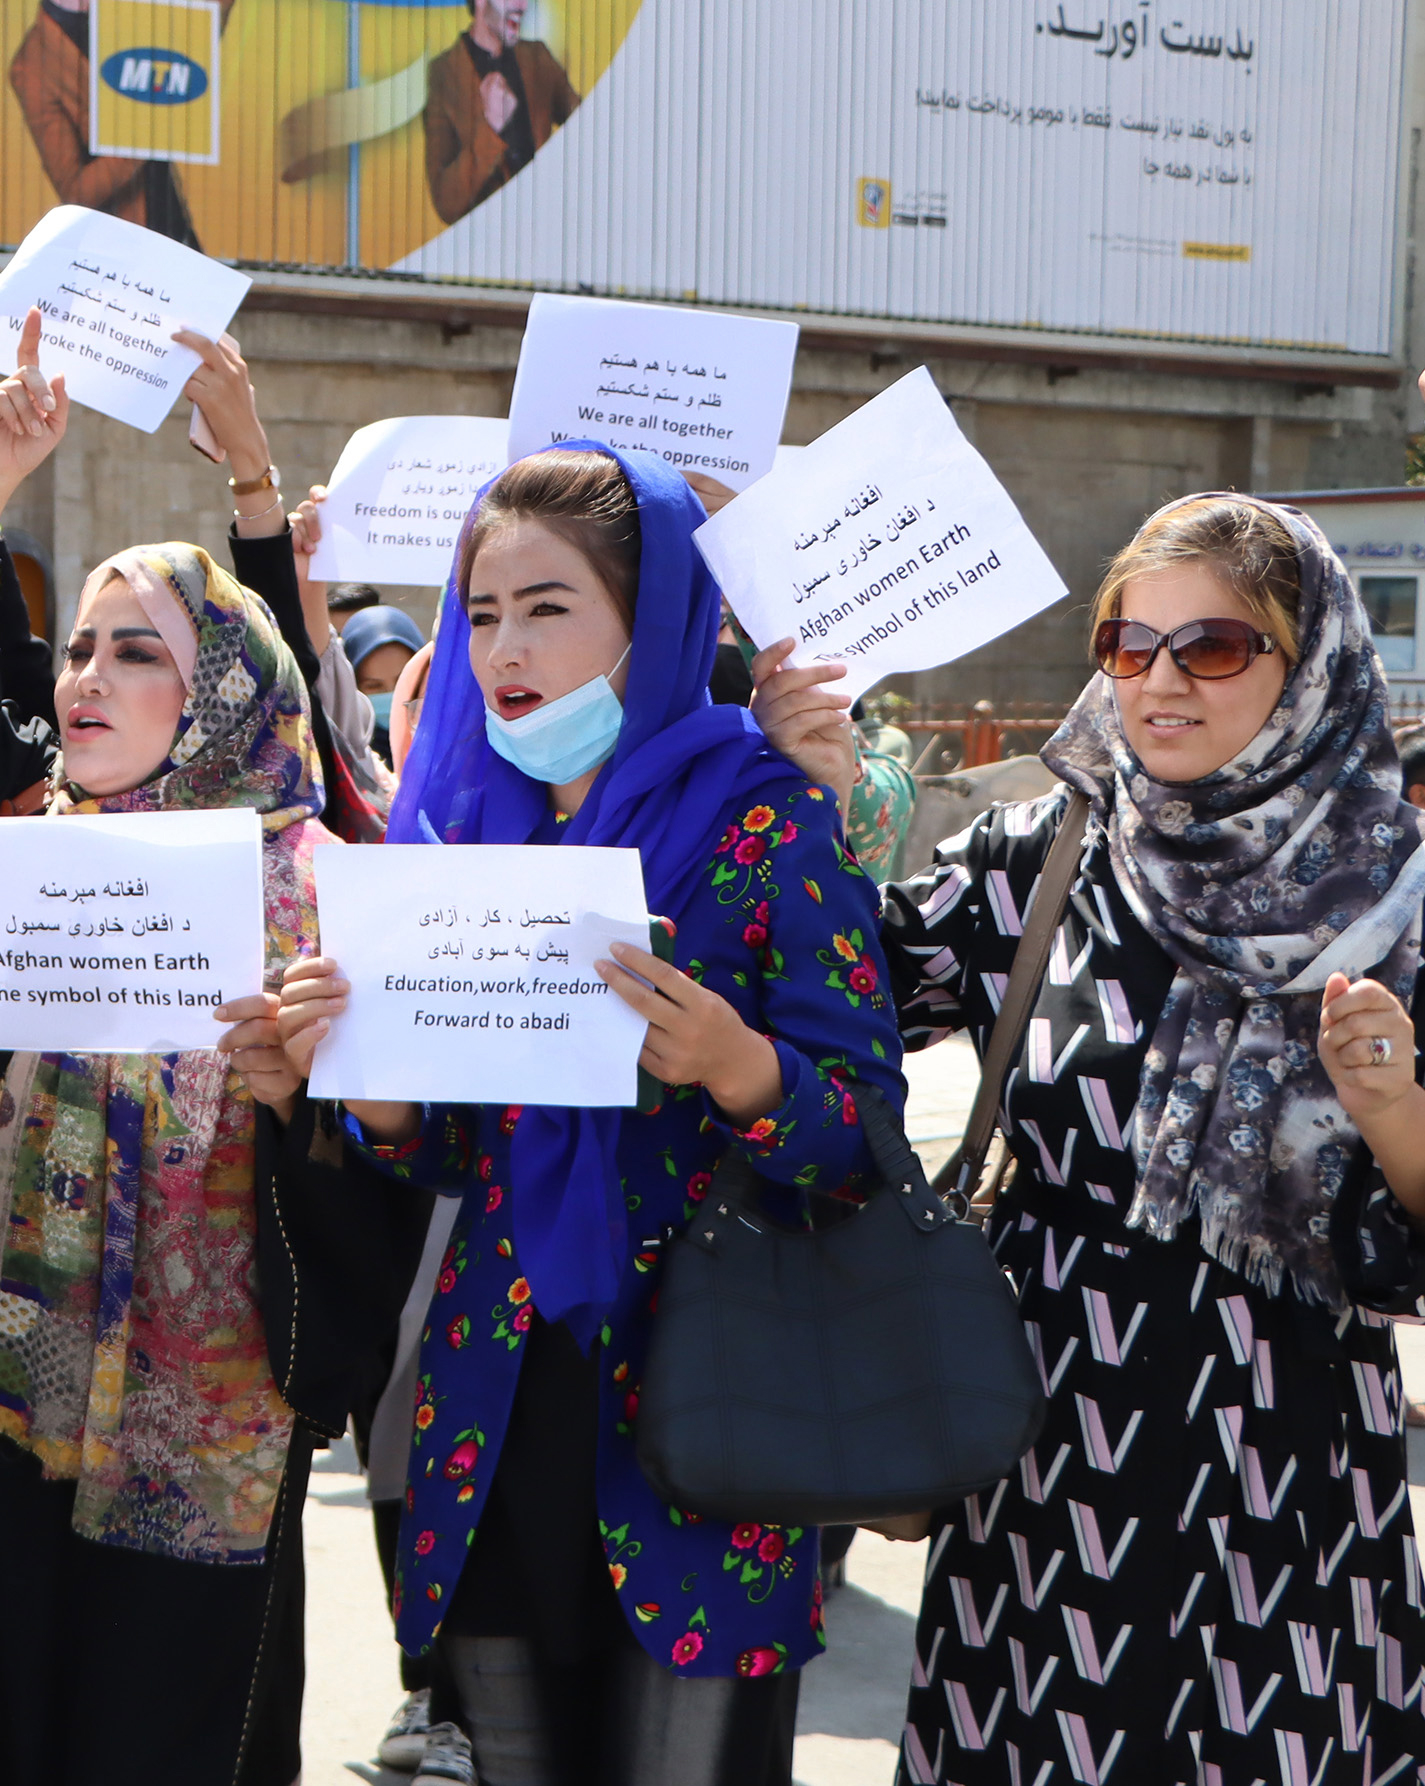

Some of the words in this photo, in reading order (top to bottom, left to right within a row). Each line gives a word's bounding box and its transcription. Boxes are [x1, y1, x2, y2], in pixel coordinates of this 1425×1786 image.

[119, 57, 191, 96] MTN
[37, 297, 58, 316] We
[62, 311, 85, 326] are
[88, 314, 106, 335] all
[109, 327, 168, 358] together
[79, 344, 102, 361] the
[106, 355, 168, 389] oppression
[578, 406, 604, 422] We
[608, 413, 634, 427] are
[638, 414, 657, 430] all
[662, 419, 734, 441] together
[663, 450, 749, 473] oppression
[355, 503, 421, 519] Freedom
[427, 506, 437, 519] is
[844, 484, 883, 518] افغانه
[926, 499, 935, 512] د
[886, 504, 921, 542] افغان
[368, 531, 378, 544] It
[383, 531, 431, 547] makes
[437, 536, 452, 547] us
[798, 602, 854, 643] Afghan
[854, 558, 920, 607] women
[919, 523, 971, 565] Earth
[844, 612, 904, 656] symbol
[904, 598, 924, 622] of
[923, 581, 959, 610] this
[956, 549, 1002, 589] land
[103, 877, 149, 897] افغانه
[6, 914, 60, 935] سمبول
[132, 913, 173, 937] افغان
[182, 919, 191, 931] د
[419, 905, 457, 927] آزادی
[479, 909, 501, 927] کار
[520, 909, 571, 928] تحصیل
[428, 938, 464, 960] آبادی
[471, 946, 508, 961] سوی
[515, 943, 530, 961] به
[536, 941, 569, 965] پیش
[69, 955, 147, 970] women
[154, 952, 210, 971] Earth
[384, 974, 609, 996] Education,work,freedom
[27, 986, 101, 1007] symbol
[107, 987, 128, 1004] of
[134, 988, 171, 1006] this
[178, 989, 222, 1007] land
[414, 1010, 489, 1028] Forward
[495, 1012, 514, 1029] to
[519, 1011, 570, 1030] abadi
